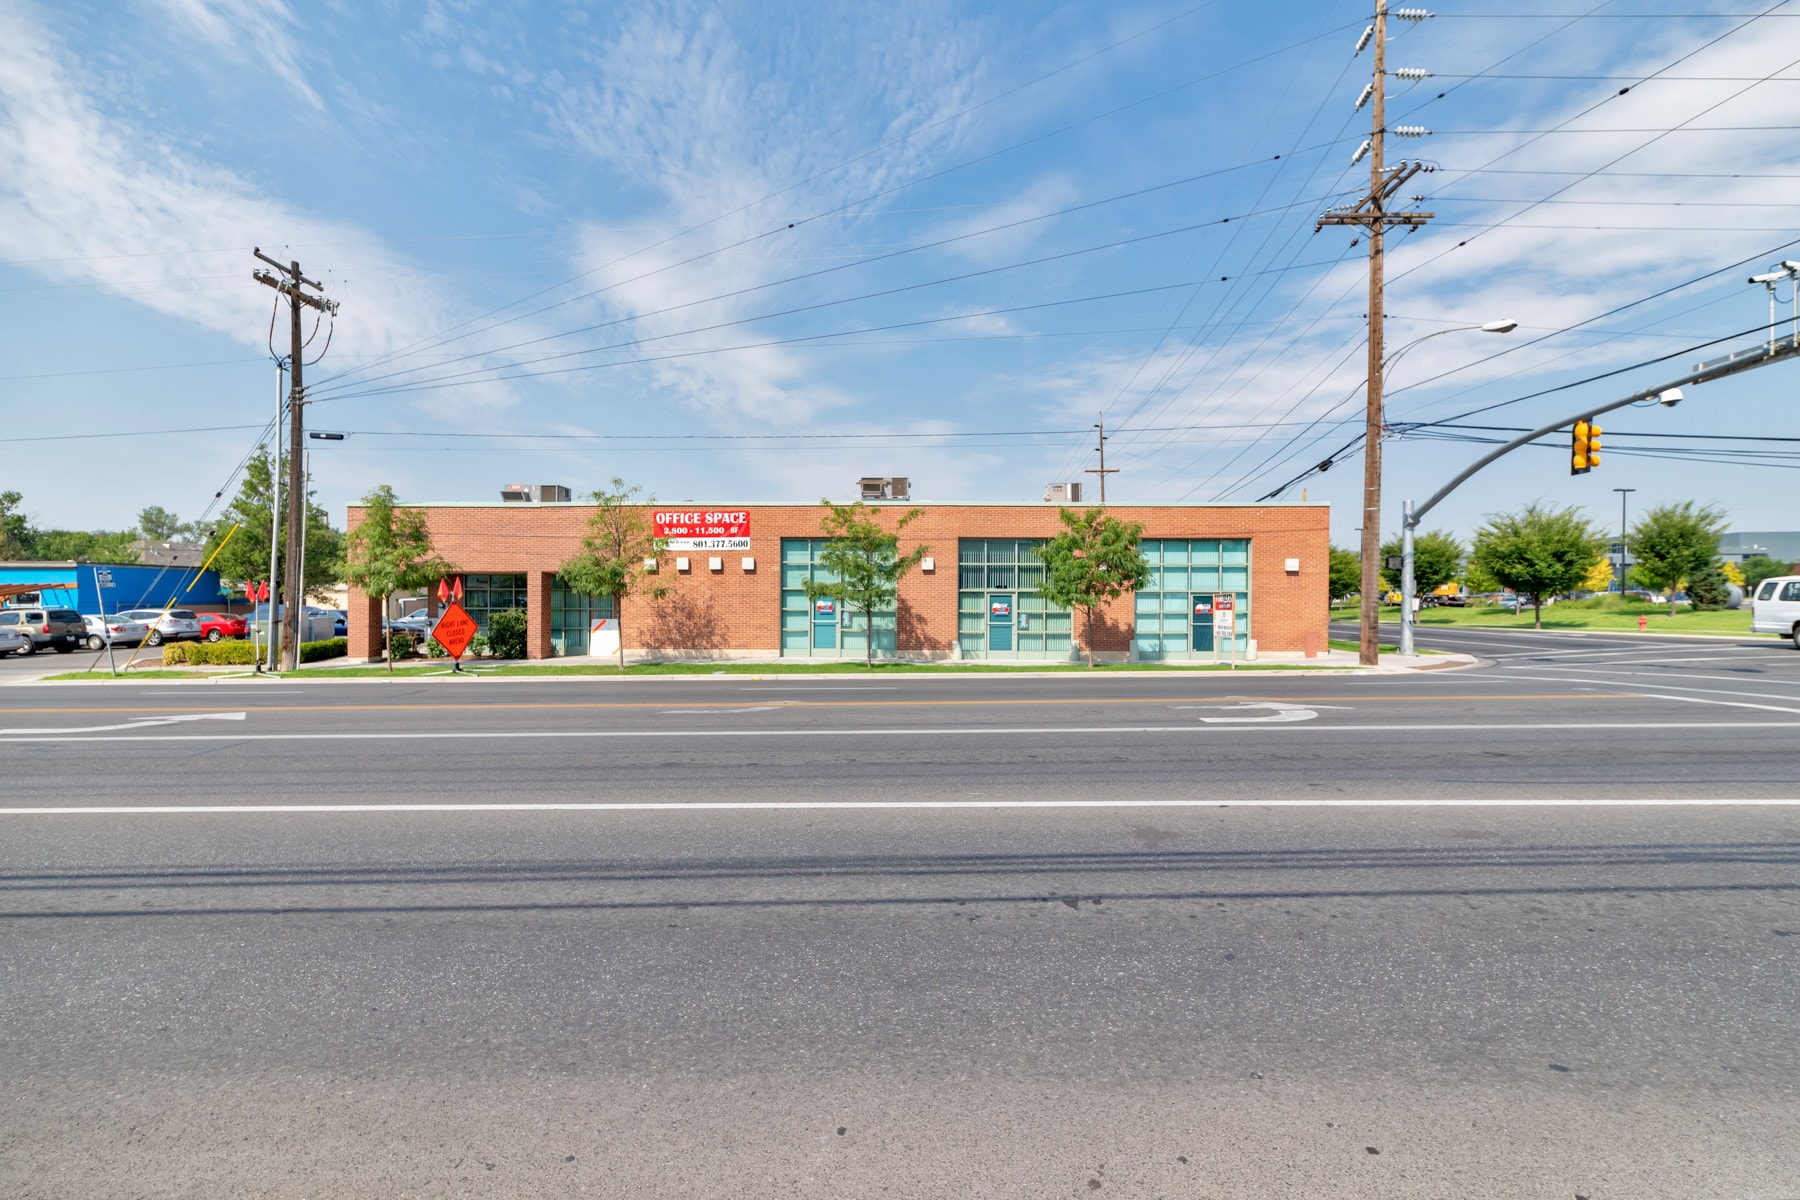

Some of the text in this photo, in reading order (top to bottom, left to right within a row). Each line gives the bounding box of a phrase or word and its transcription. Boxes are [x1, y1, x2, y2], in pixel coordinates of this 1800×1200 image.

[656, 512, 747, 524] OFFICE SPACE
[695, 527, 725, 535] 11,500
[693, 540, 748, 548] 801.377.5600
[441, 619, 469, 629] RIGHT LANE
[446, 628, 465, 637] CLOSED
[449, 637, 464, 645] AHEAD
